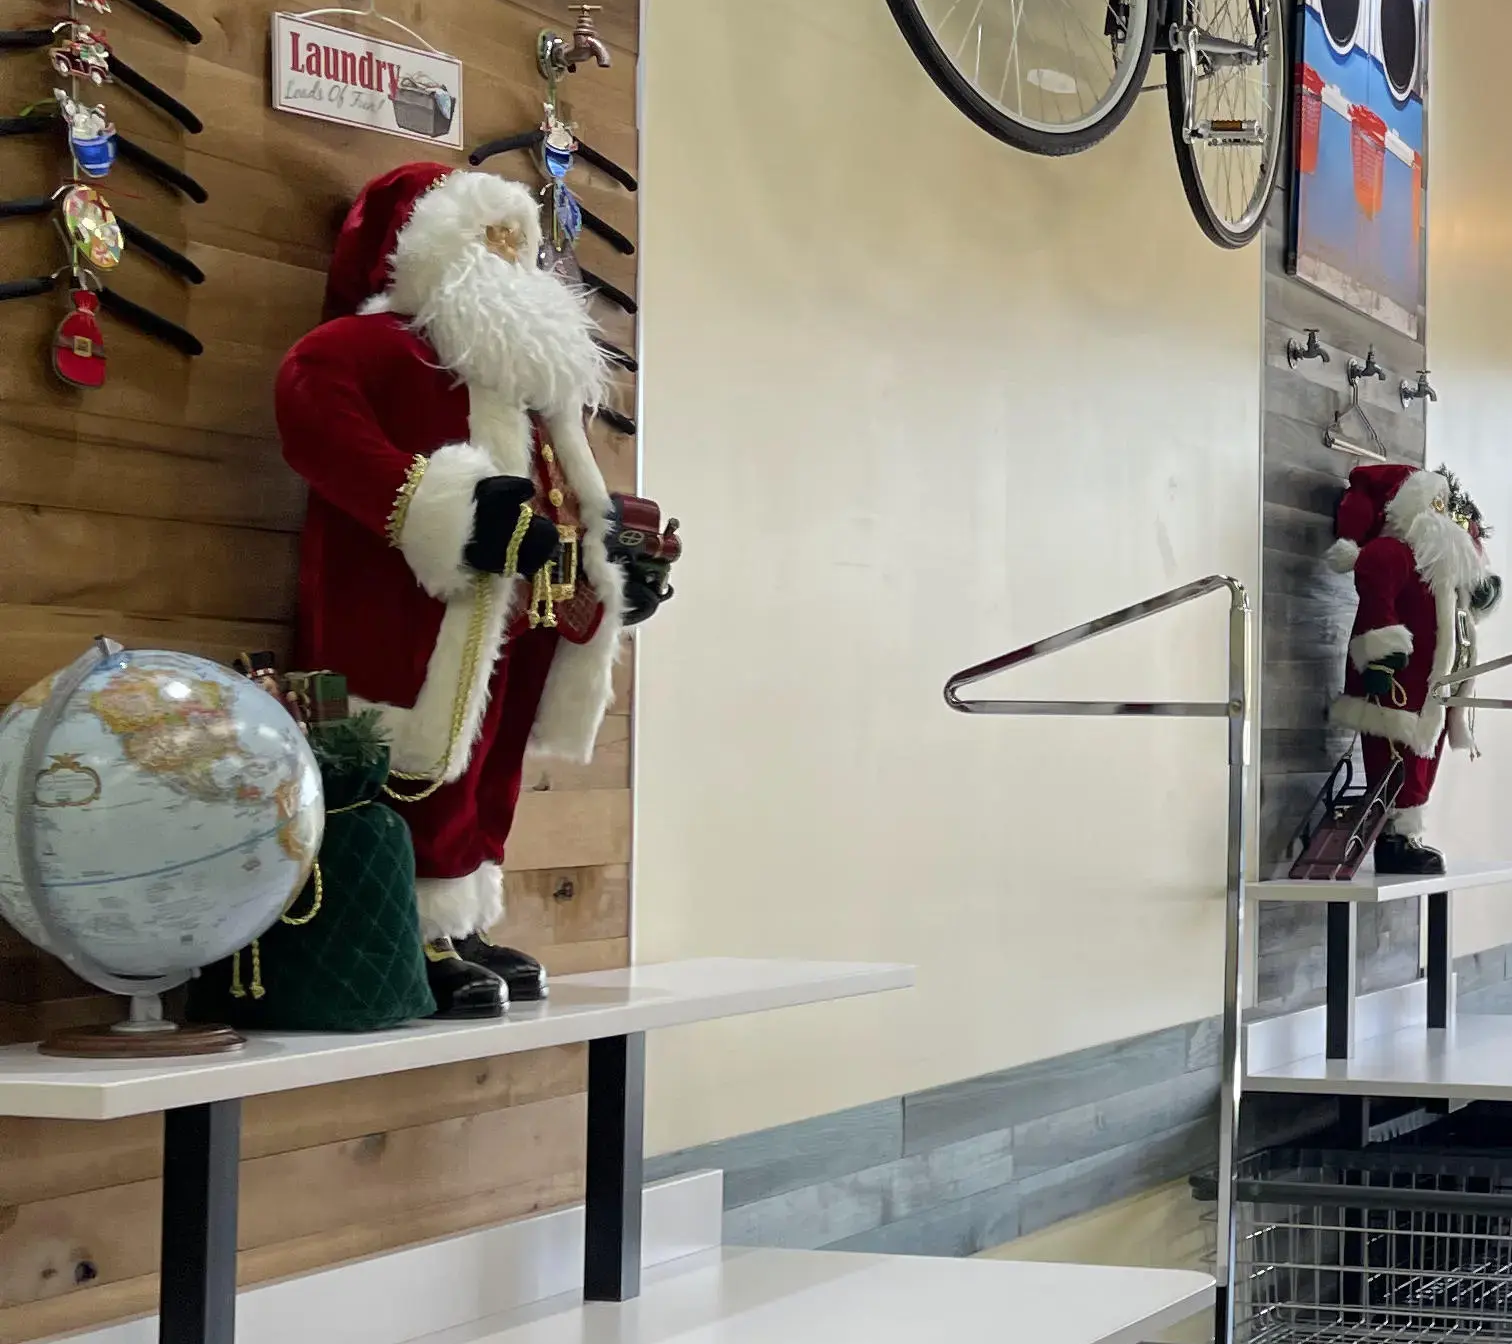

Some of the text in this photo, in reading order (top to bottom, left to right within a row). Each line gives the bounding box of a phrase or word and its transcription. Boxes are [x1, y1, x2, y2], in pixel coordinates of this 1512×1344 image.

[284, 77, 323, 102] Loads
[327, 84, 346, 104] Of
[289, 31, 401, 102] Laundry
